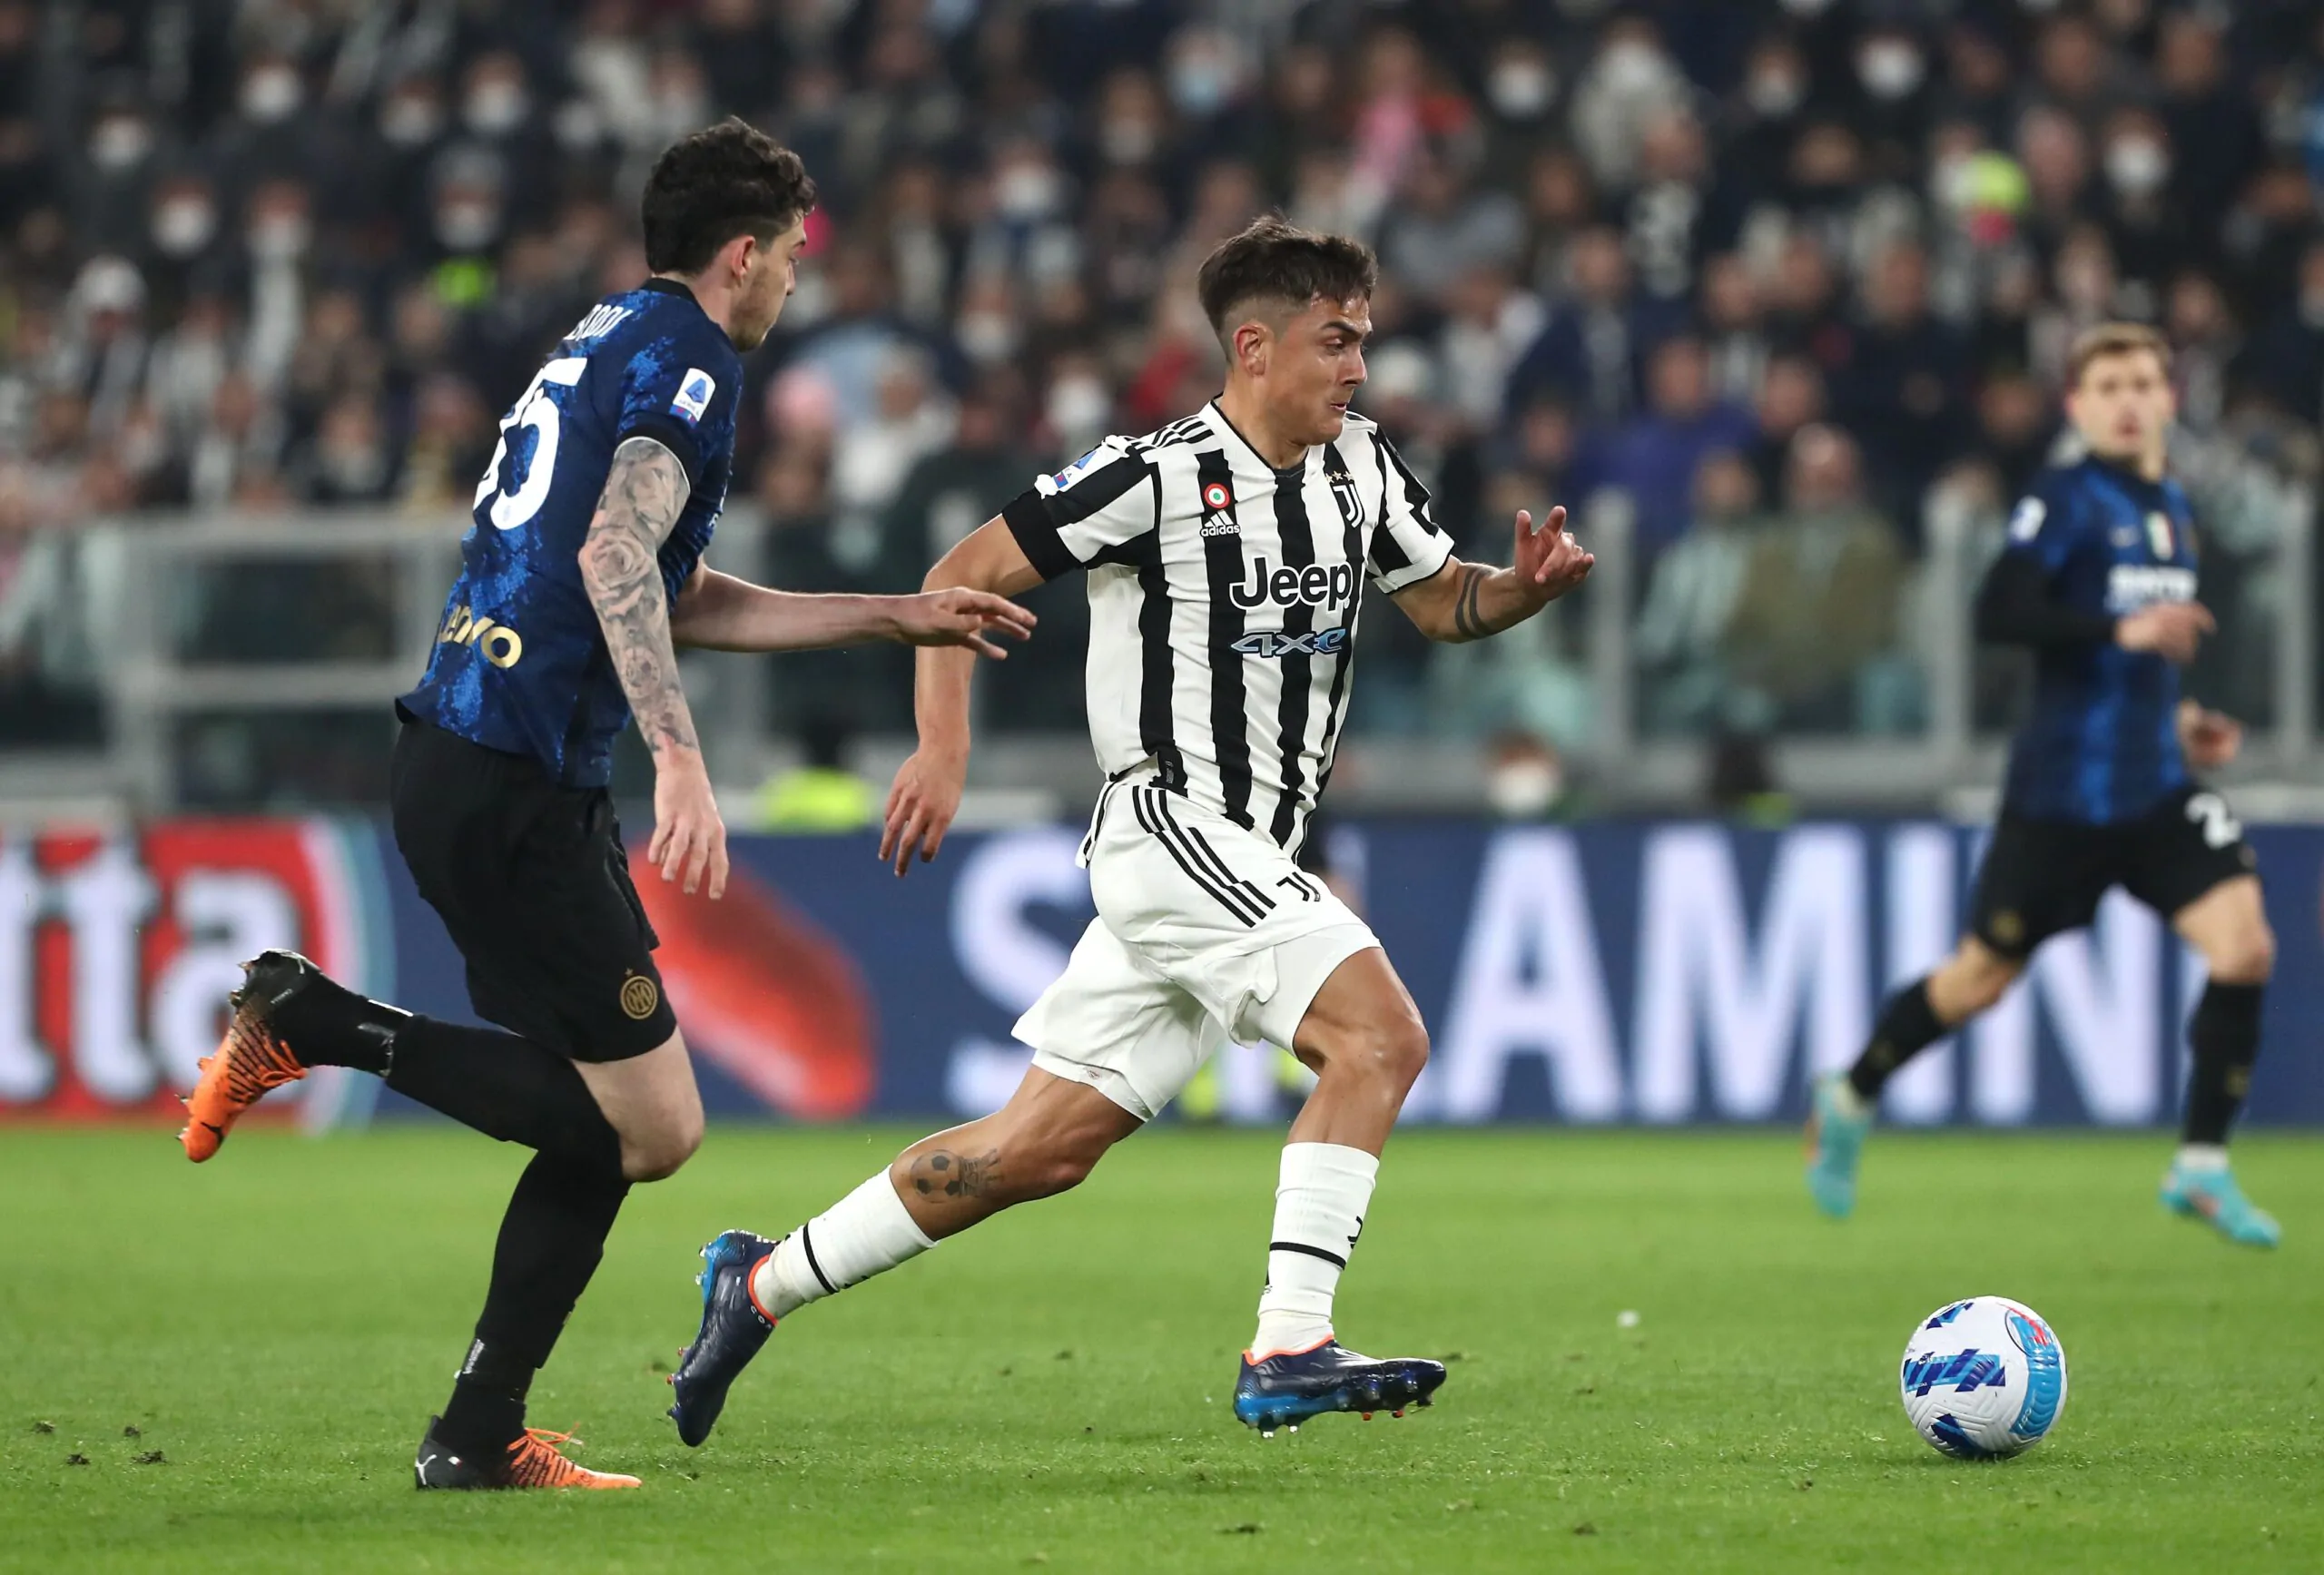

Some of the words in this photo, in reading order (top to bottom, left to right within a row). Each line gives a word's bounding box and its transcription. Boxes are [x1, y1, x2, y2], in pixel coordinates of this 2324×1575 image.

[1200, 525, 1240, 536] adidas
[1231, 556, 1353, 613] Jeep
[1230, 628, 1347, 656] 4xe
